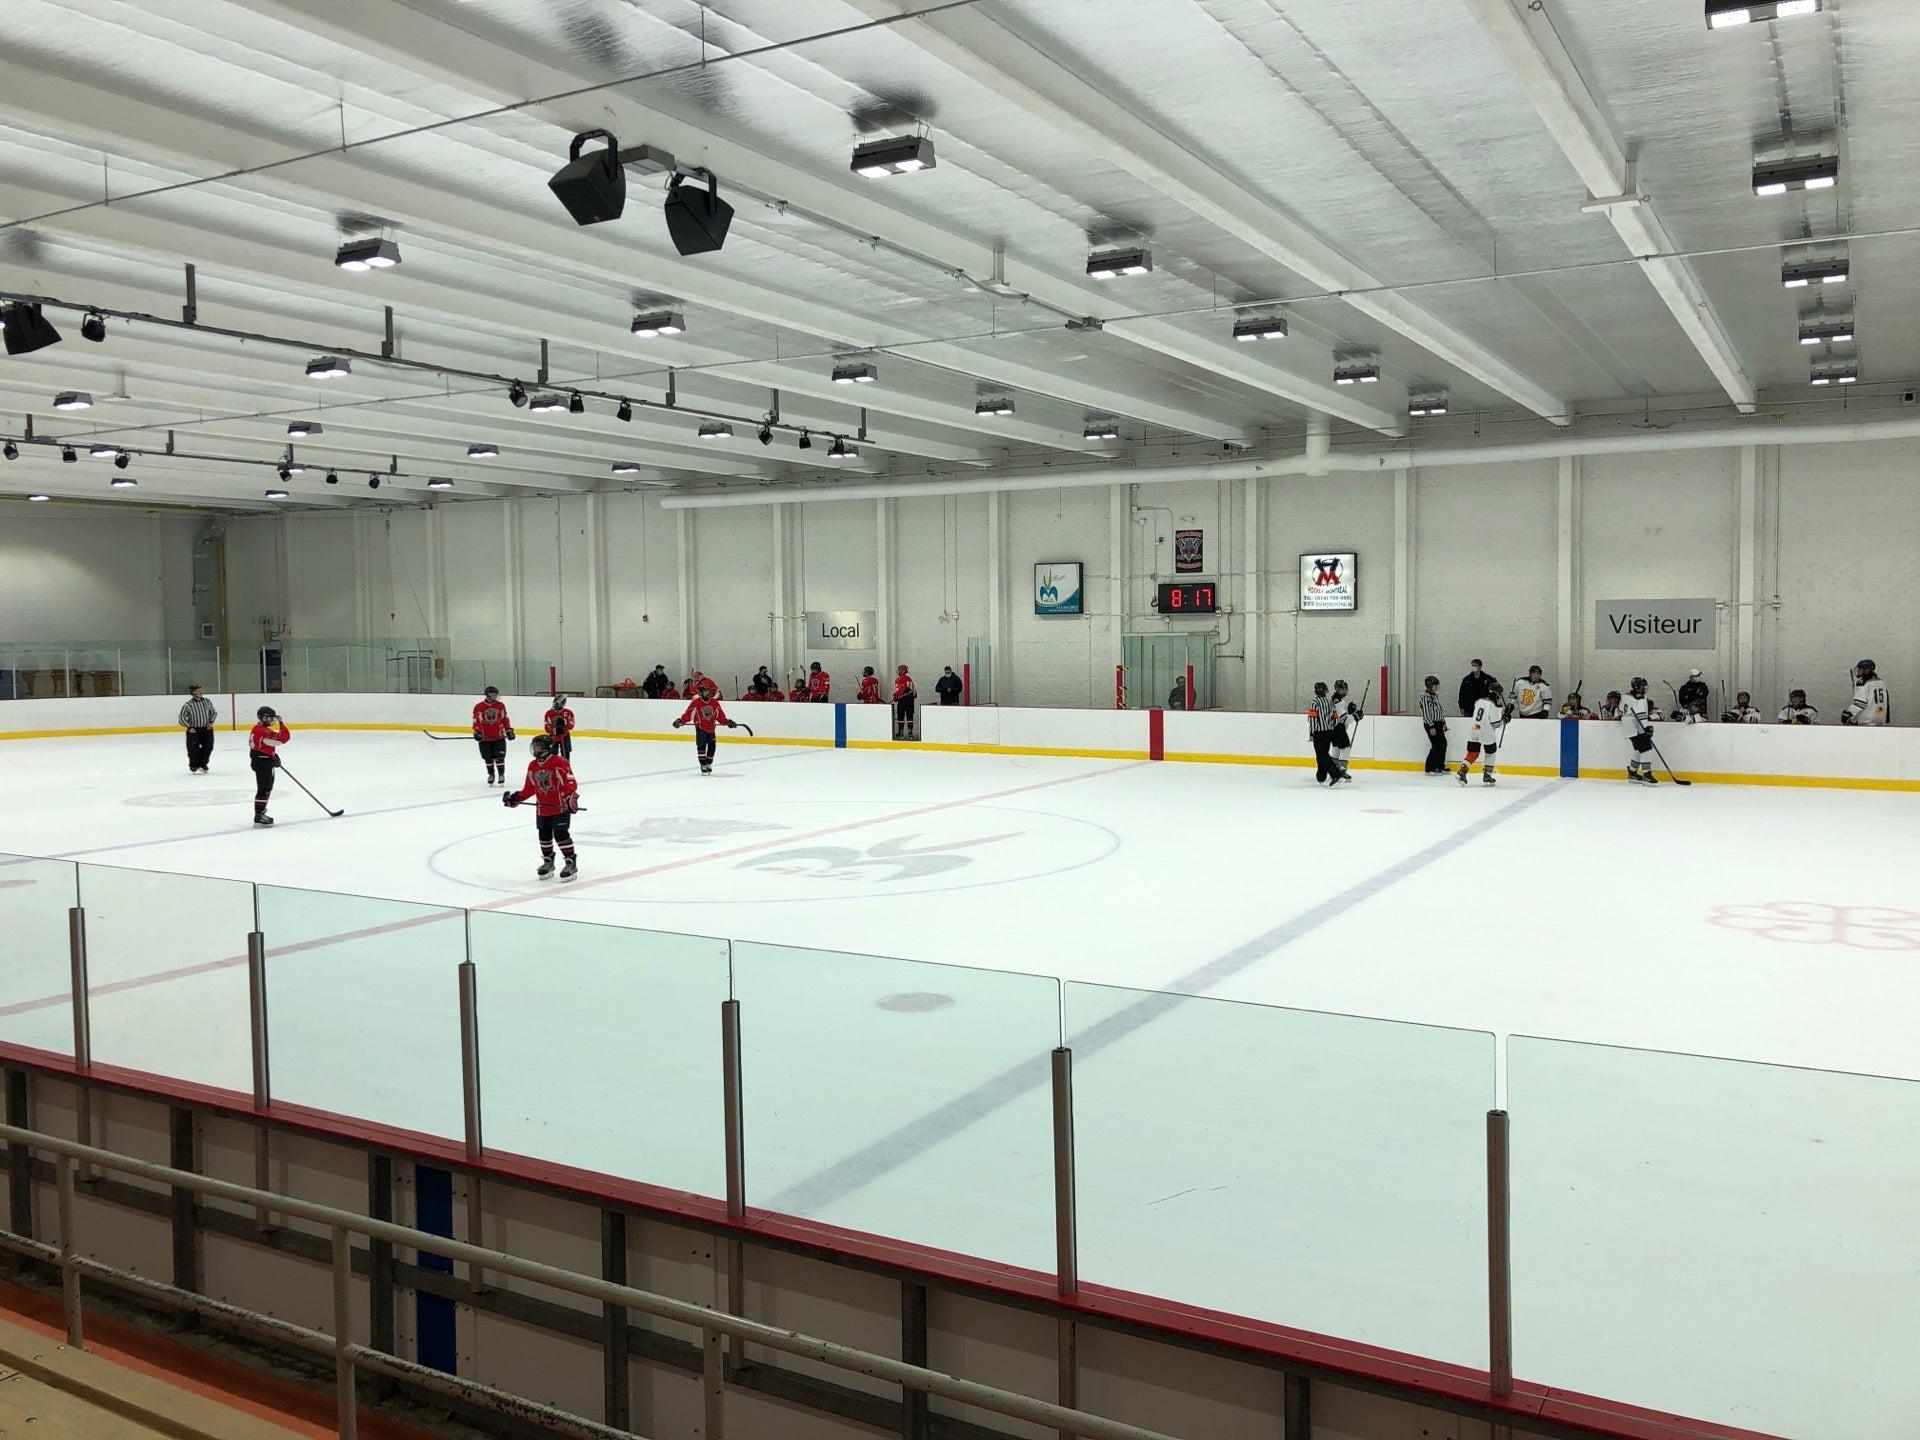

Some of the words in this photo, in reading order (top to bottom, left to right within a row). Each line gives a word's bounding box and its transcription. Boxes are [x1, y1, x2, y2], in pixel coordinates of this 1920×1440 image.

[822, 623, 859, 638] Local
[1608, 613, 1702, 634] Visiteur
[1521, 688, 1536, 706] B
[1873, 688, 1884, 704] 15
[1475, 707, 1484, 722] 9
